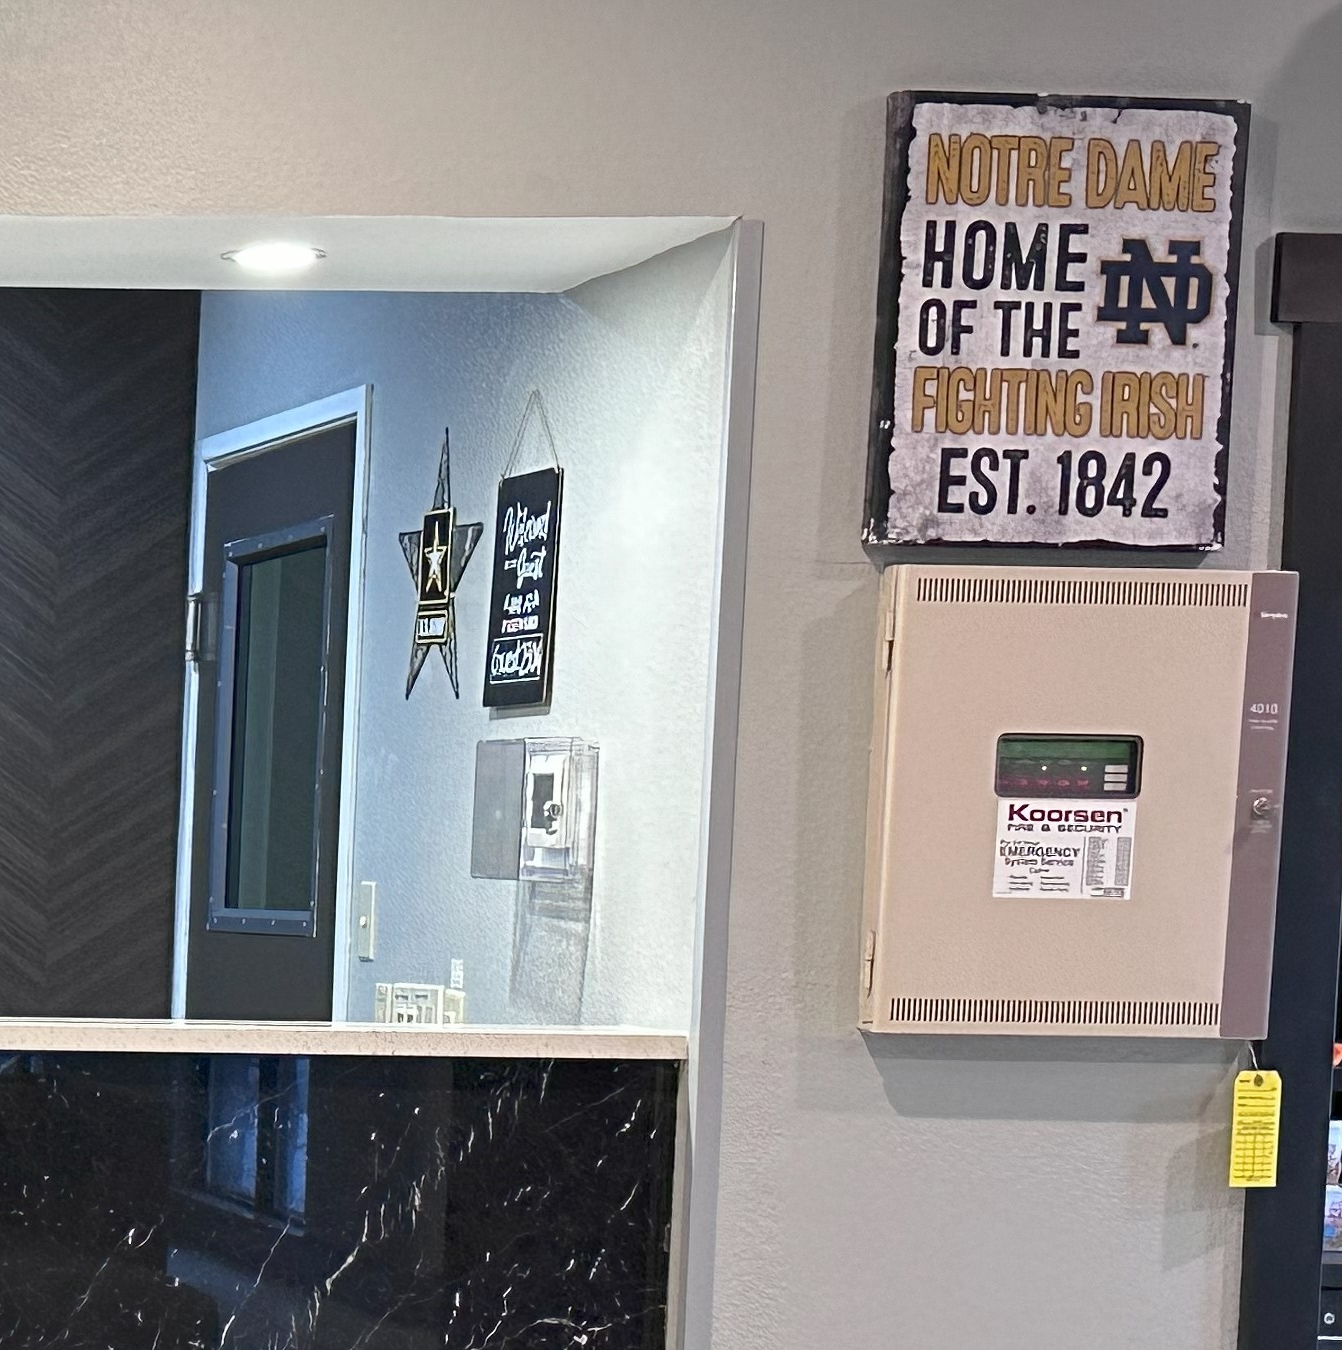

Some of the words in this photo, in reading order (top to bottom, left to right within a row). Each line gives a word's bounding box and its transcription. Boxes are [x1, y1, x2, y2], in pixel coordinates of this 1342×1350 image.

[926, 133, 1074, 208] NOTRE
[1086, 138, 1220, 212] DAME
[921, 220, 1089, 292] HOME
[918, 299, 977, 357] OF
[994, 301, 1083, 359] THE
[912, 366, 1094, 438] FIGHTING
[1099, 371, 1205, 440] IRISH
[937, 448, 1036, 515] EST.
[1057, 449, 1172, 519] 1842
[1008, 804, 1122, 823] Koorsen
